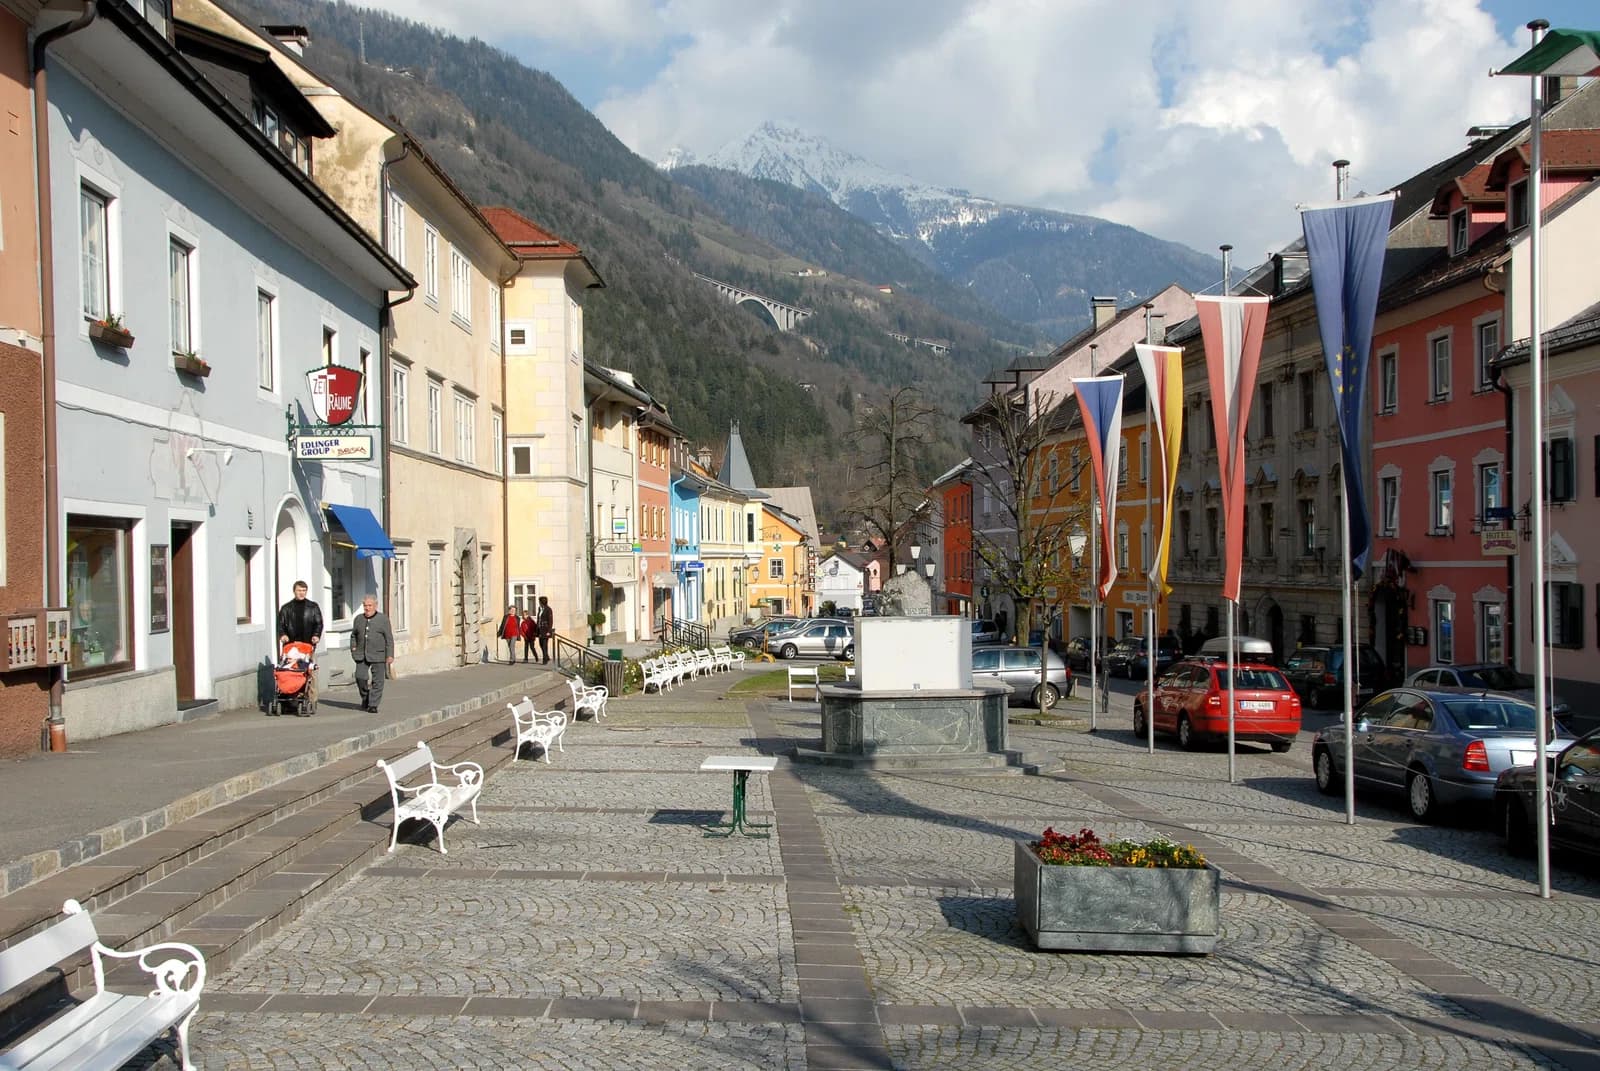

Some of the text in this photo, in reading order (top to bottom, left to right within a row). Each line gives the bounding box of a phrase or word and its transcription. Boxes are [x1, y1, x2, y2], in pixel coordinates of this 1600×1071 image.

[301, 439, 339, 449] EDLINGER
[301, 447, 330, 456] GROUP
[1486, 531, 1513, 539] HOTEL
